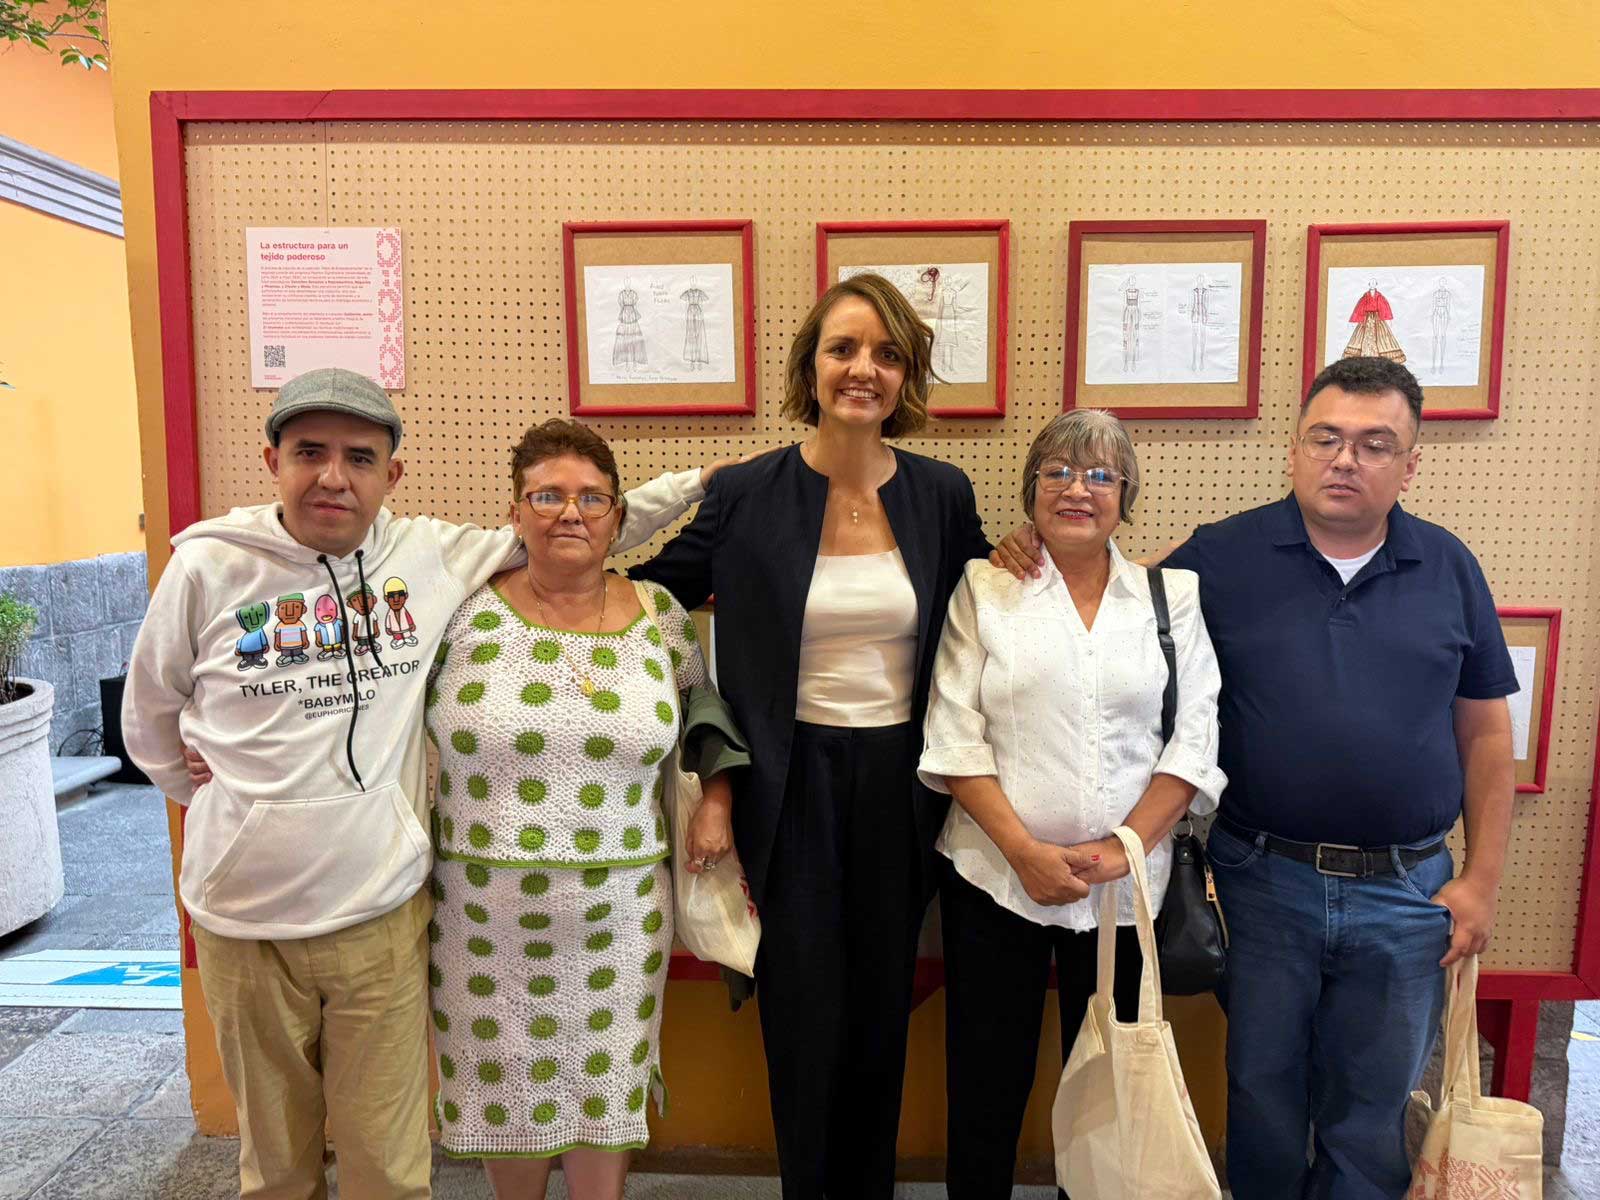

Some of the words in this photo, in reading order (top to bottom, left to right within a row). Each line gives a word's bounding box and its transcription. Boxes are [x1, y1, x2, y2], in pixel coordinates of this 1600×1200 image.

[272, 242, 315, 250] estructura
[317, 243, 336, 251] para
[260, 252, 284, 262] tejido
[286, 252, 326, 262] poderoso
[239, 679, 303, 698] TYLER,
[306, 673, 342, 689] THE
[297, 689, 376, 709] BABYMLO
